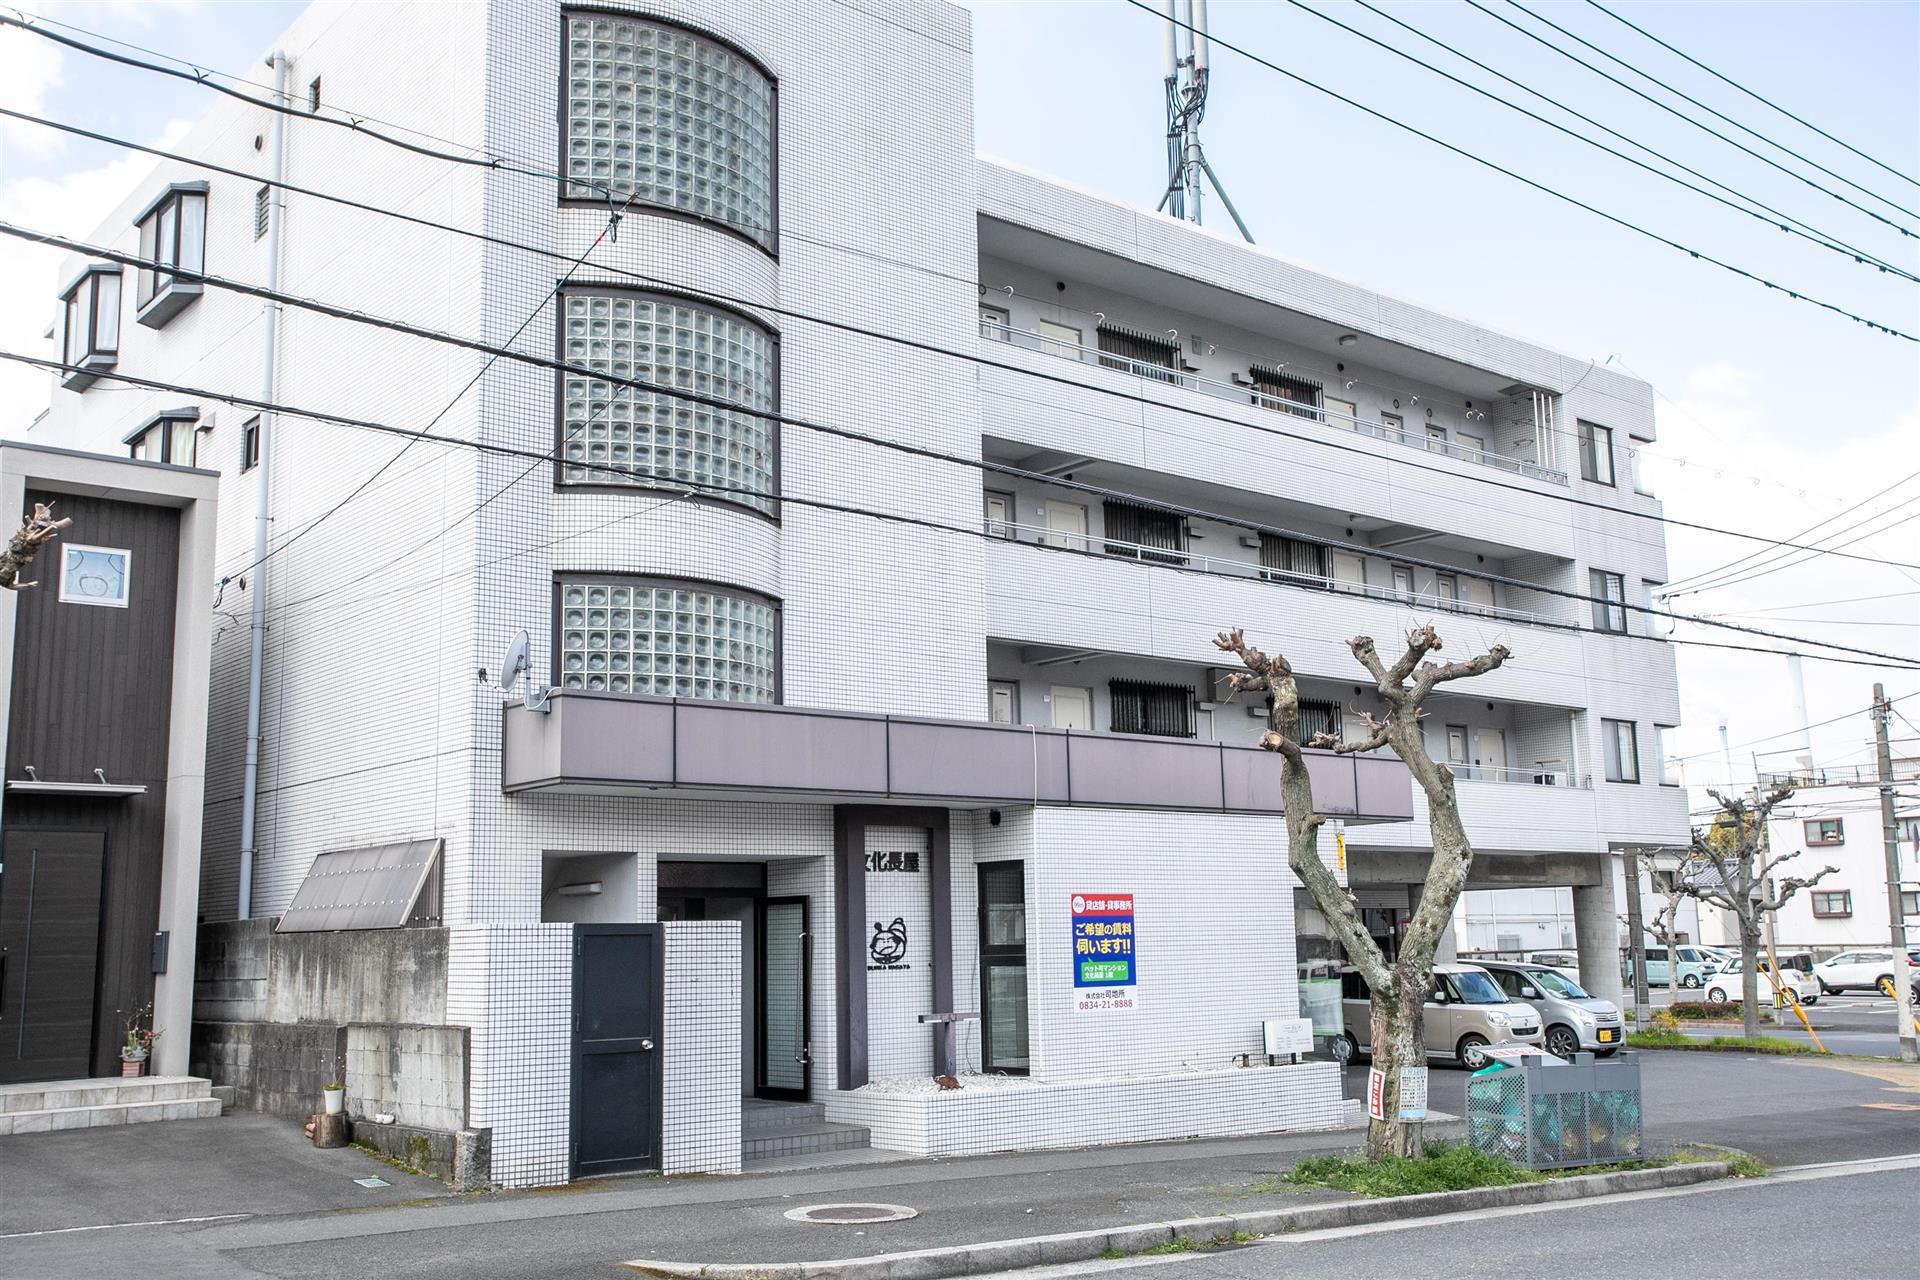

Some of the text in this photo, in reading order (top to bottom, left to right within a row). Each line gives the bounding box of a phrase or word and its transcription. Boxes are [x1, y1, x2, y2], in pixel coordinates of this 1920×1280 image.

[1075, 922, 1132, 936] ご希望の賃料
[1079, 999, 1133, 1010] 0834-21-8888
